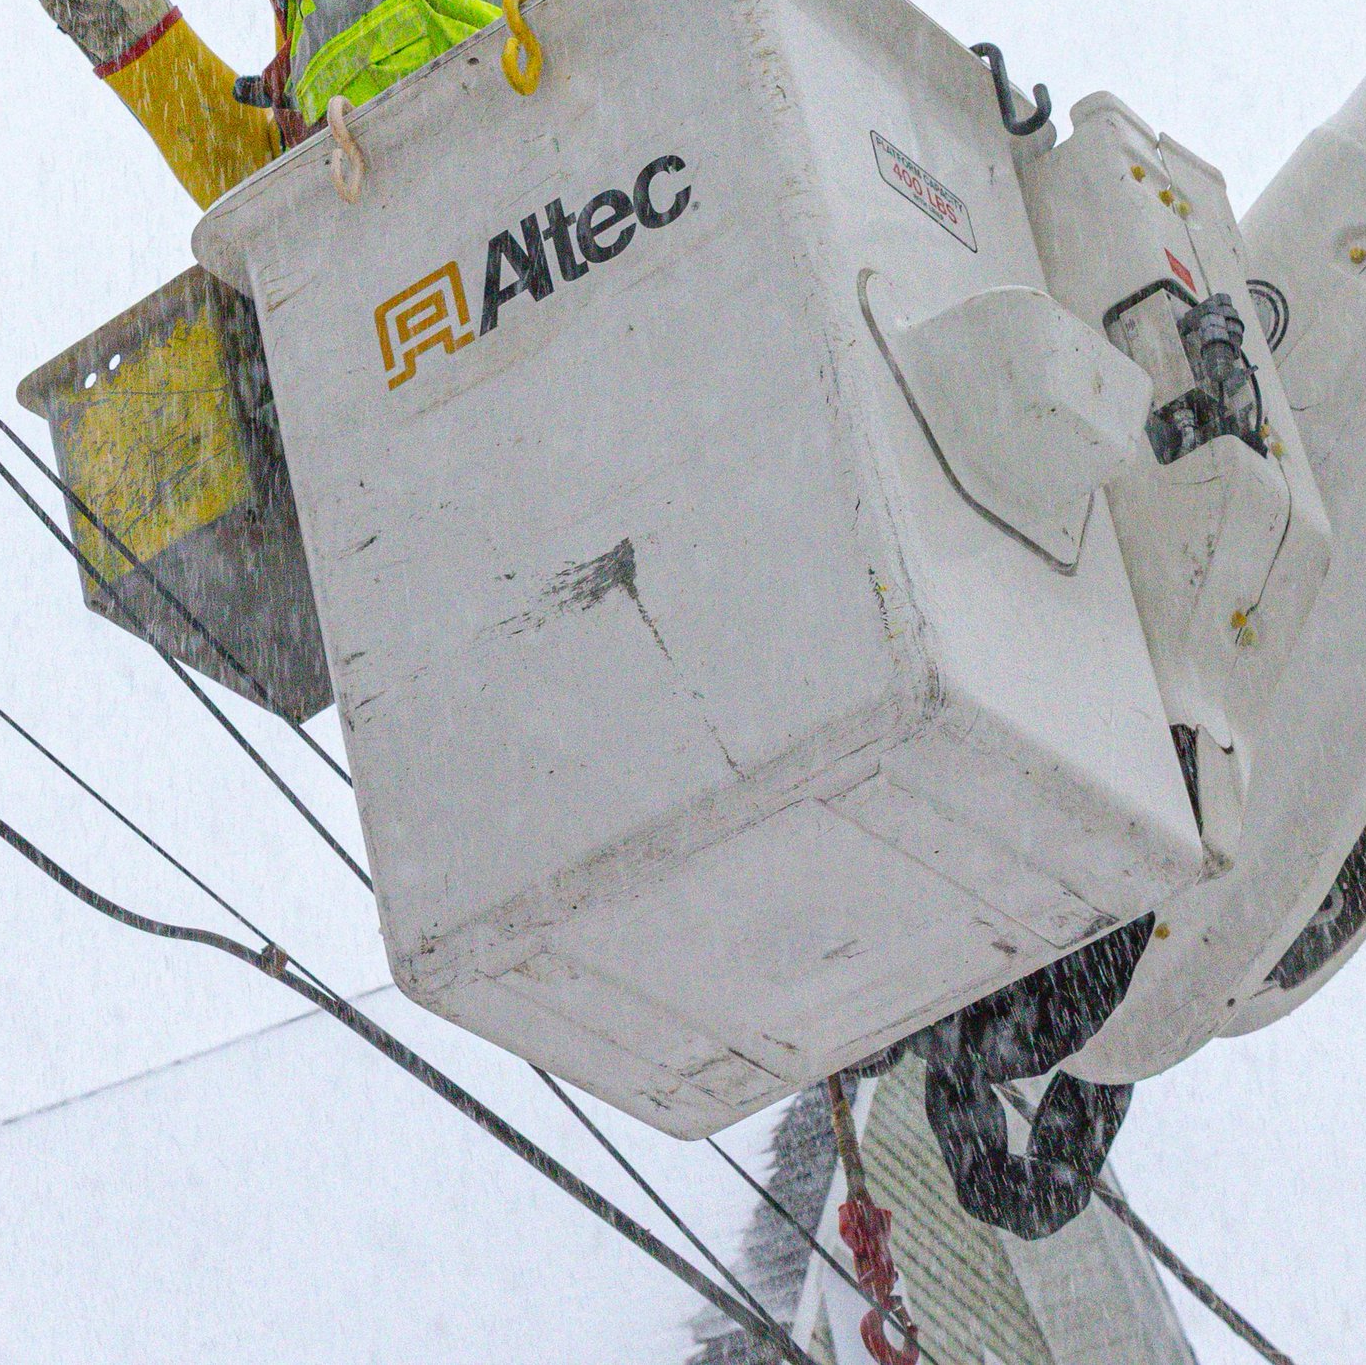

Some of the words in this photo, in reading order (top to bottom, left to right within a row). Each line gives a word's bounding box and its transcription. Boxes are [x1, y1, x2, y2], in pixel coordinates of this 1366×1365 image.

[875, 136, 922, 179] PLATFORM
[893, 163, 923, 196] 400
[926, 187, 957, 224] LBS
[479, 154, 692, 337] Altec
